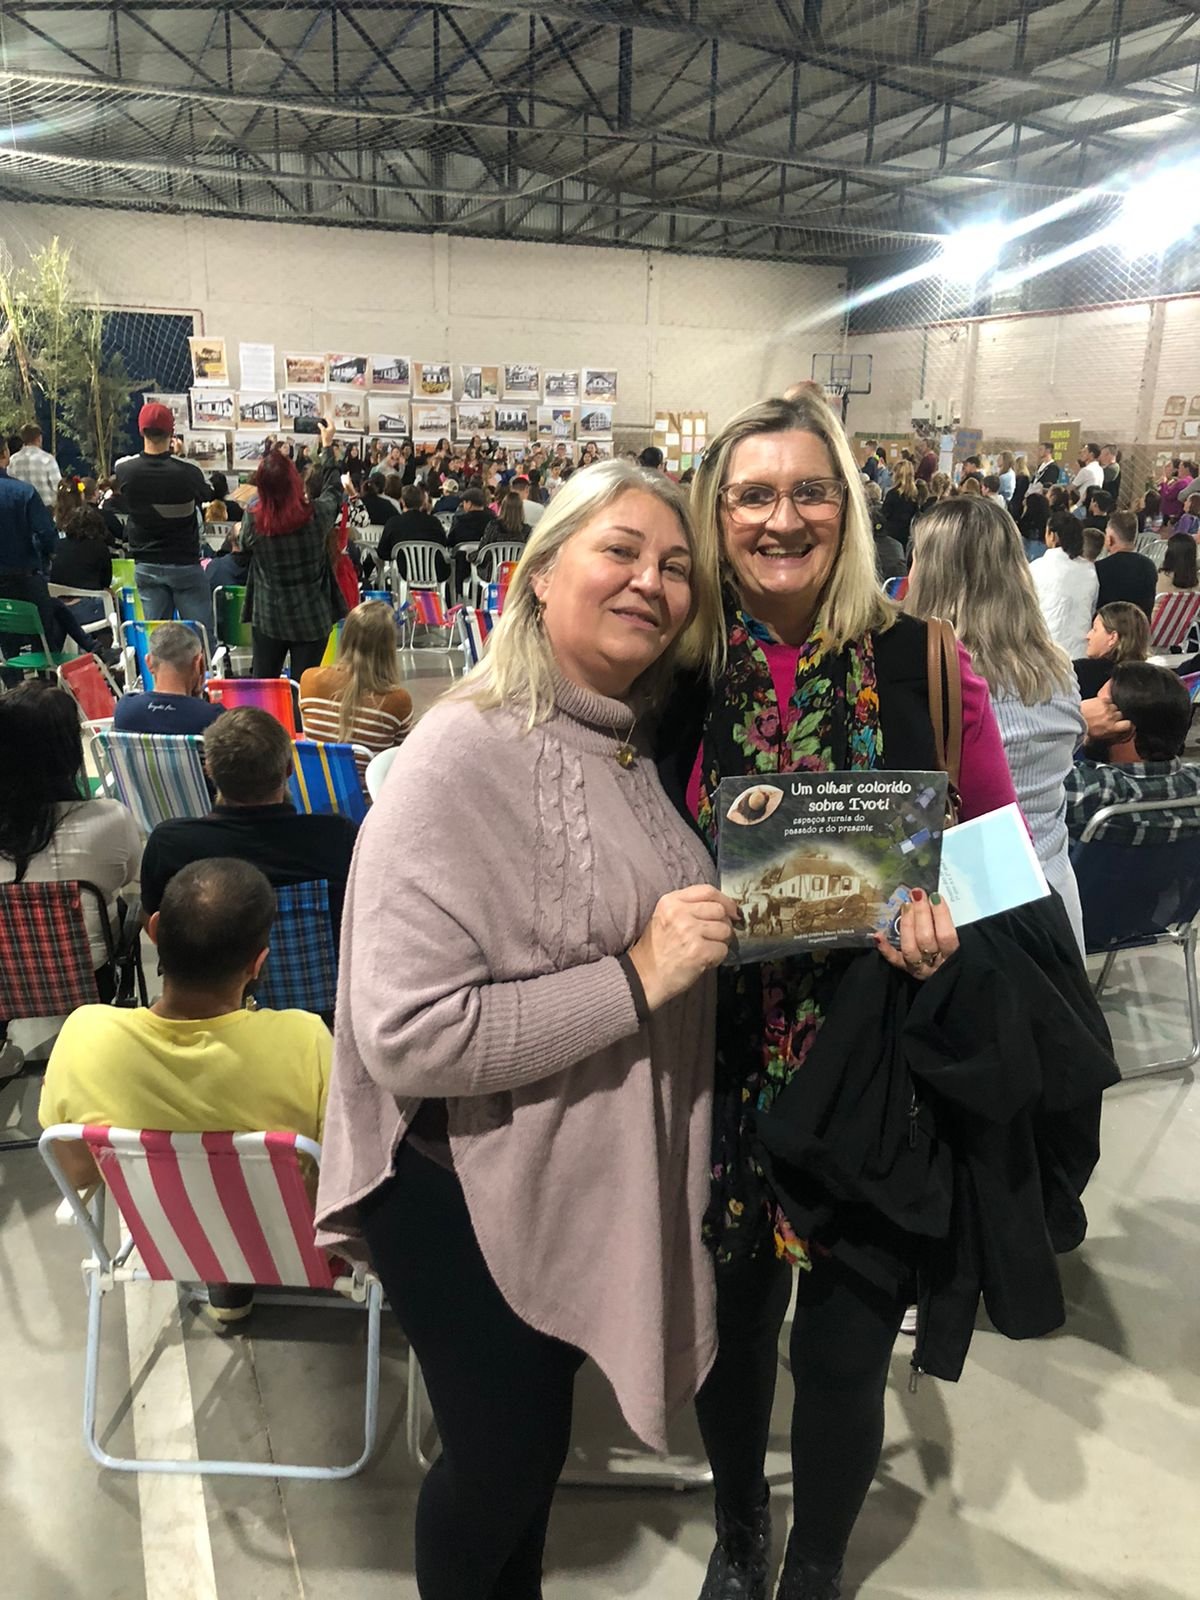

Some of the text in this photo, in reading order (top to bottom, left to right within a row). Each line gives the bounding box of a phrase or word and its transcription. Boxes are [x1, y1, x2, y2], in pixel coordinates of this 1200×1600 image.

[791, 780, 912, 796] Um olhar colorido
[808, 797, 890, 812] sobre Ivoti
[792, 813, 866, 825] espaços rurais do
[784, 825, 817, 837] passado
[825, 824, 836, 833] do
[838, 824, 874, 834] presente
